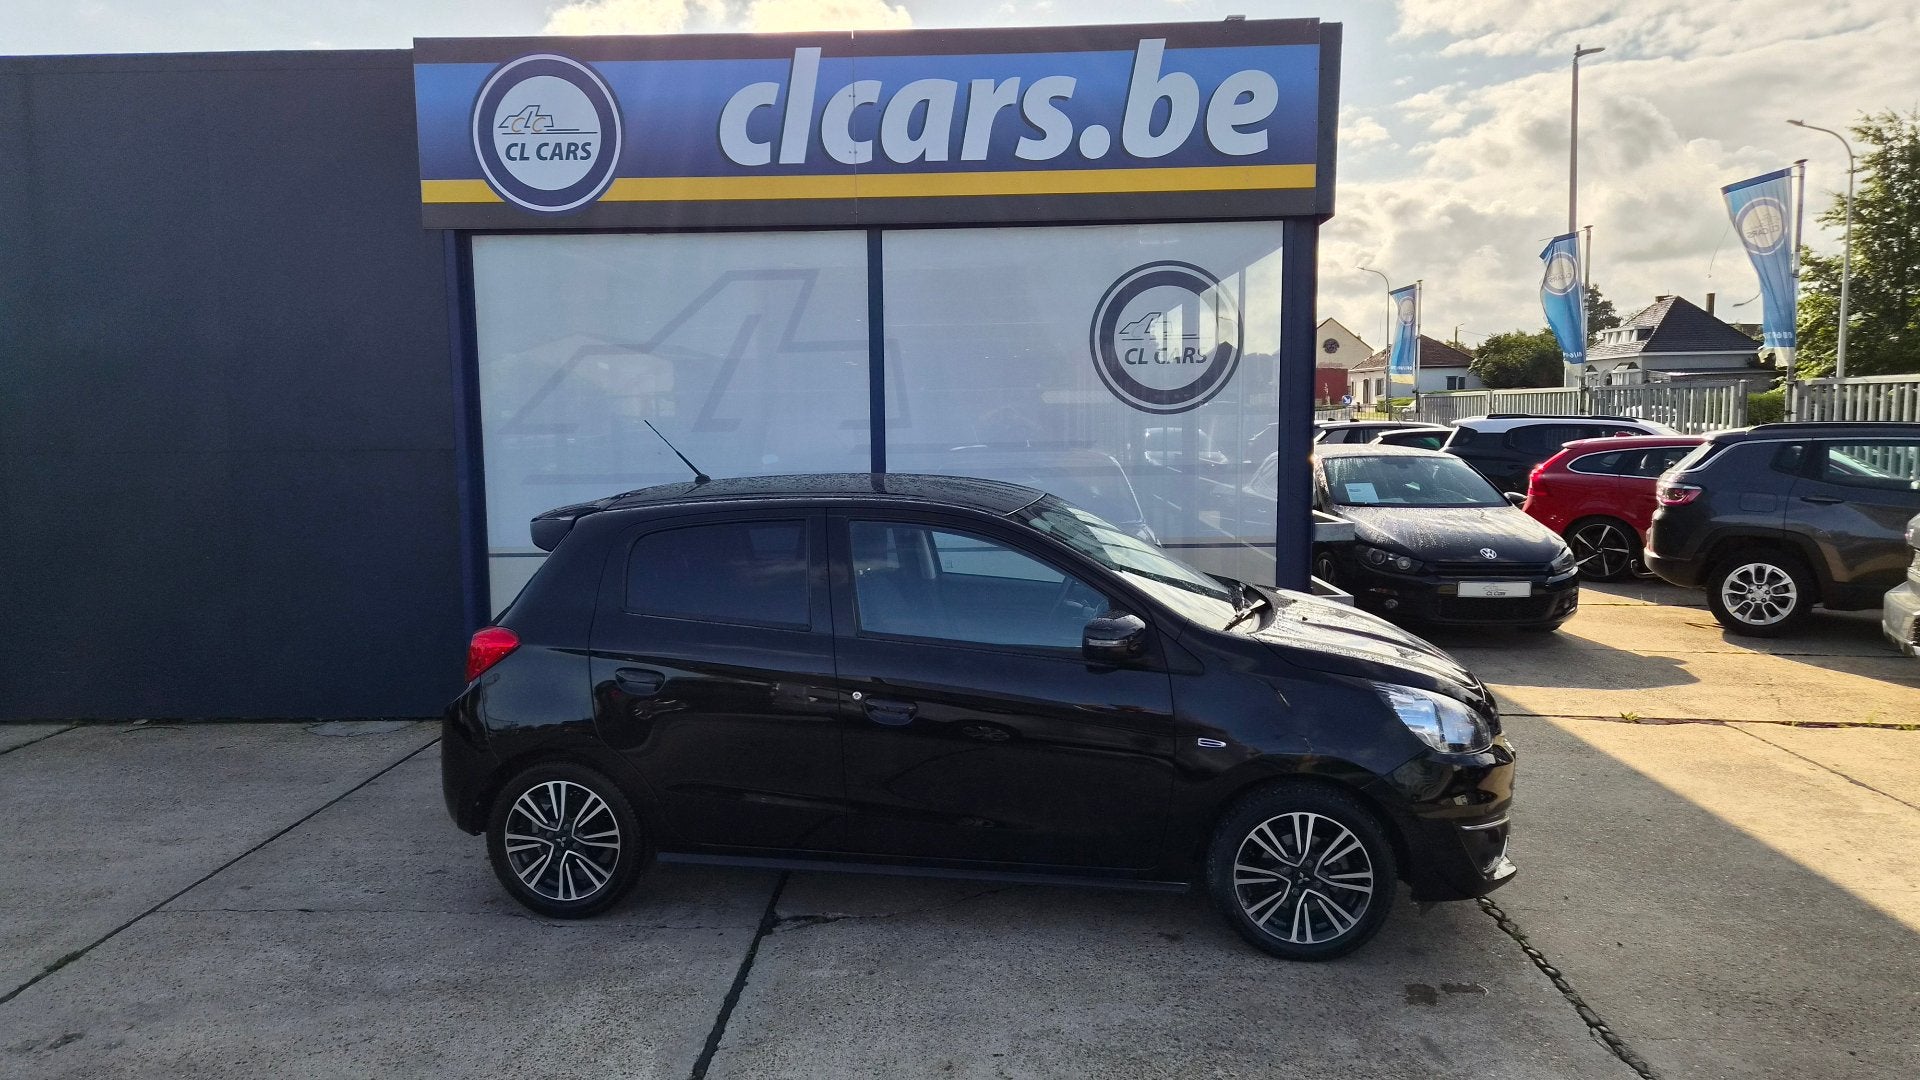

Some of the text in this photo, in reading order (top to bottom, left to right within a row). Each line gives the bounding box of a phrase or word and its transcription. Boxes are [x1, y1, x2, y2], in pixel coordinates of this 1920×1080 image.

[718, 38, 1280, 167] clcars.be
[505, 141, 593, 162] CL CARS
[1124, 346, 1208, 365] CL CARS
